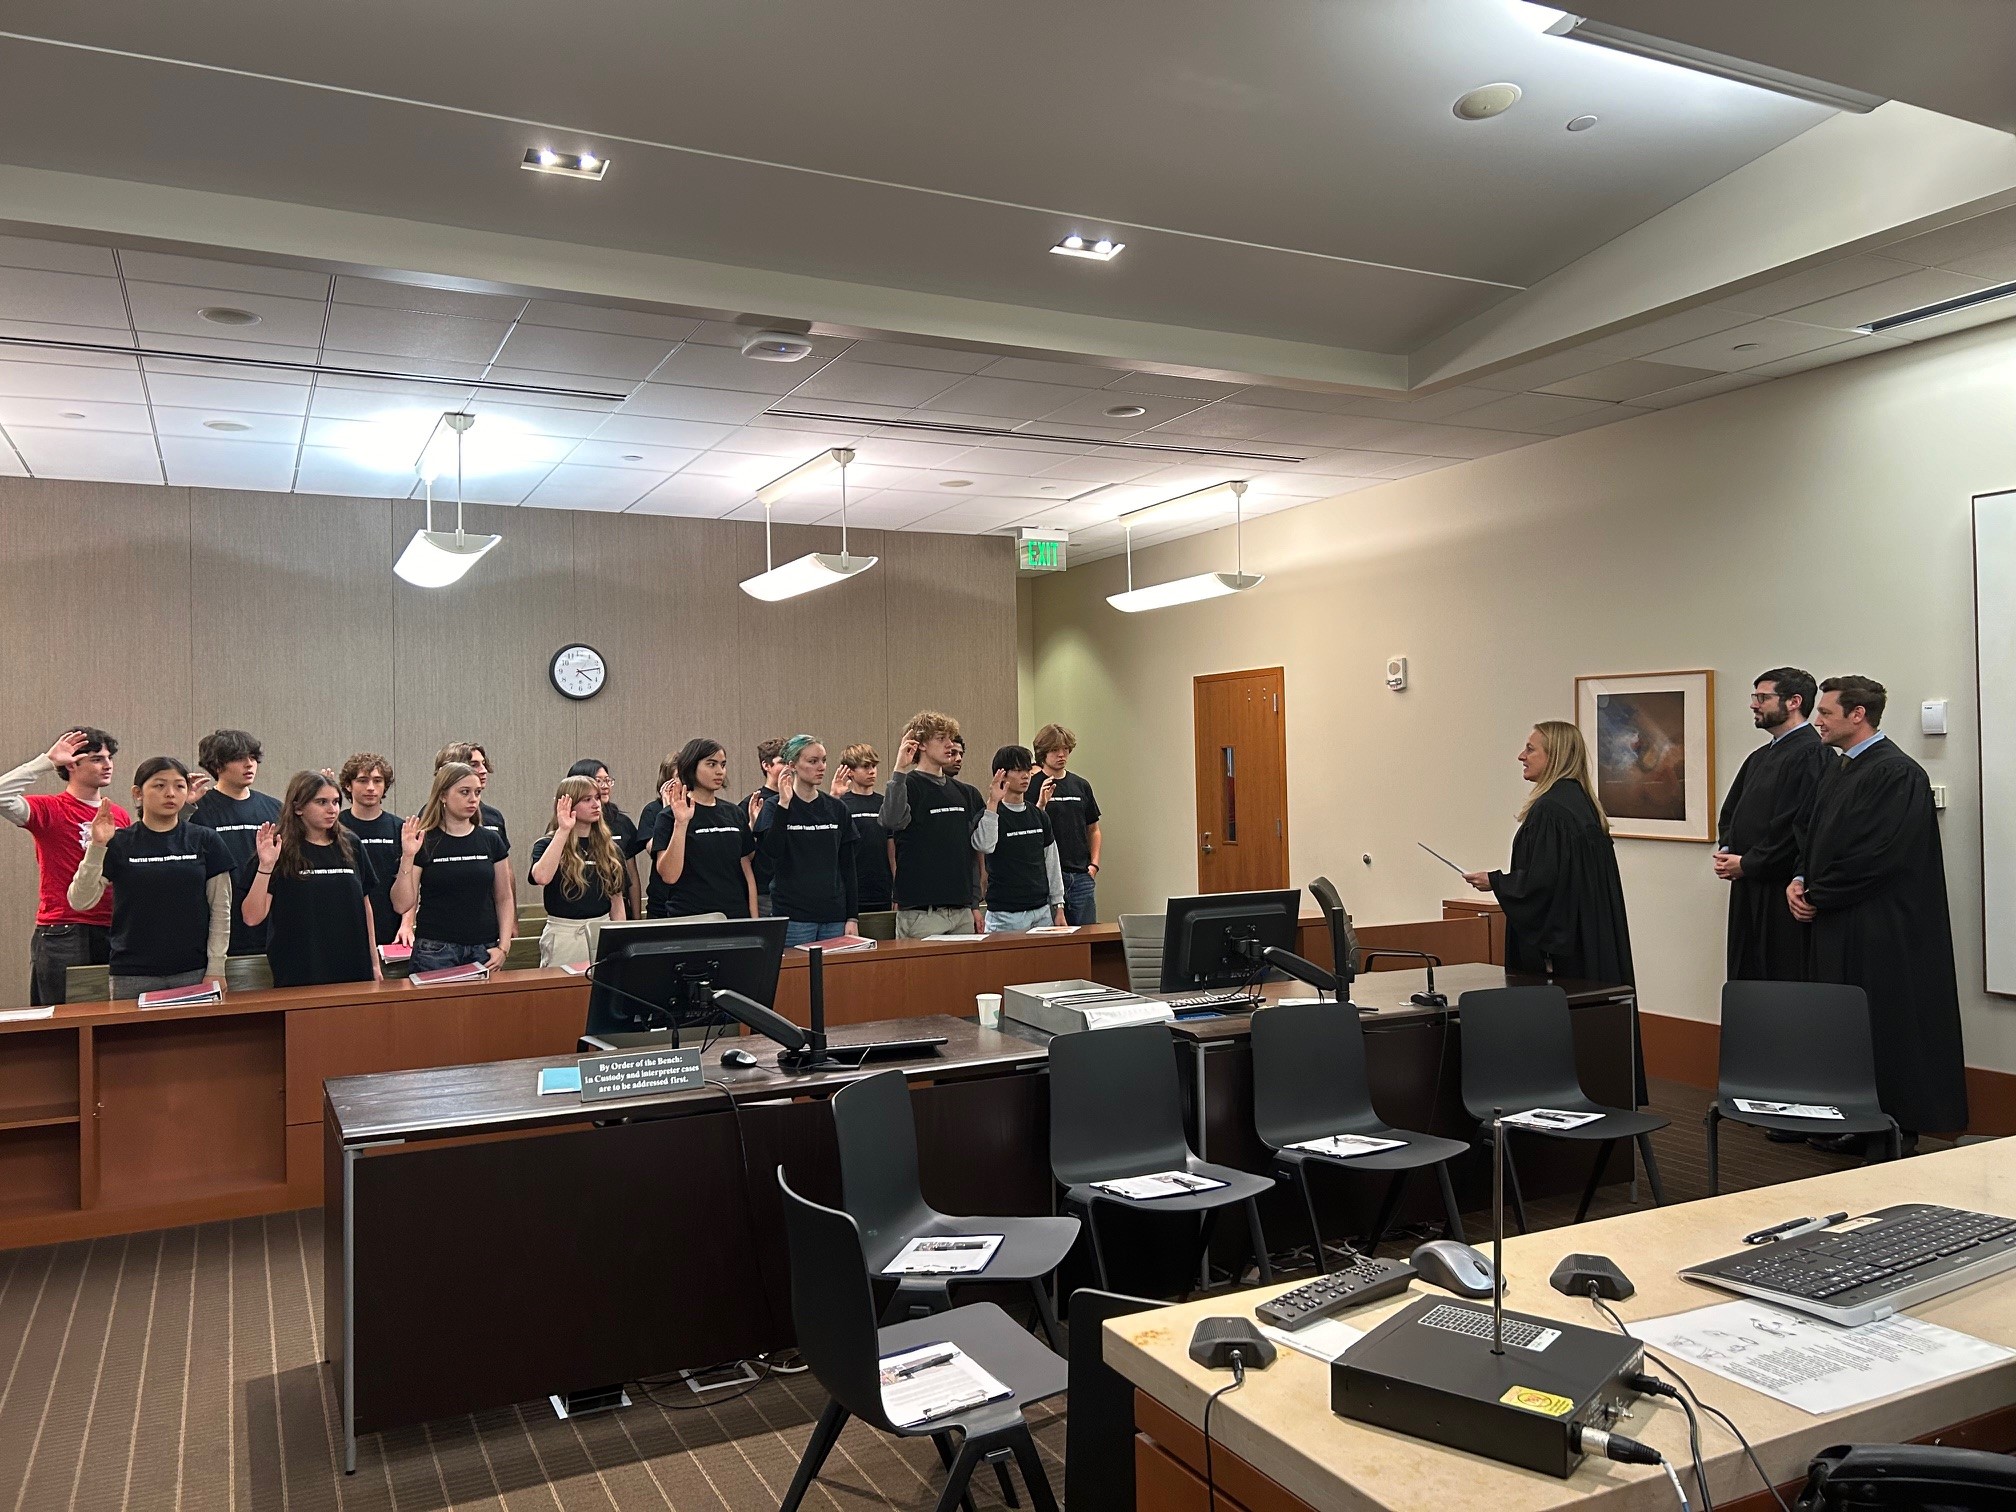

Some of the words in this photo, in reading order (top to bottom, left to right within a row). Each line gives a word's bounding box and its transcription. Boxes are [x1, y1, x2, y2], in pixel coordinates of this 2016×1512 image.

[1028, 541, 1058, 566] EXIT
[599, 1063, 610, 1073] By
[610, 1061, 634, 1071] Order
[635, 1059, 644, 1068] of
[644, 1058, 657, 1067] the
[657, 1055, 683, 1066] Bench:
[584, 1075, 594, 1084] In
[594, 1072, 625, 1083] Custody
[625, 1070, 640, 1079] and
[680, 1064, 700, 1073] cases
[598, 1085, 612, 1093] are
[612, 1083, 621, 1091] to
[621, 1082, 631, 1091] be
[631, 1077, 669, 1089] addressed
[670, 1075, 689, 1085] first.
